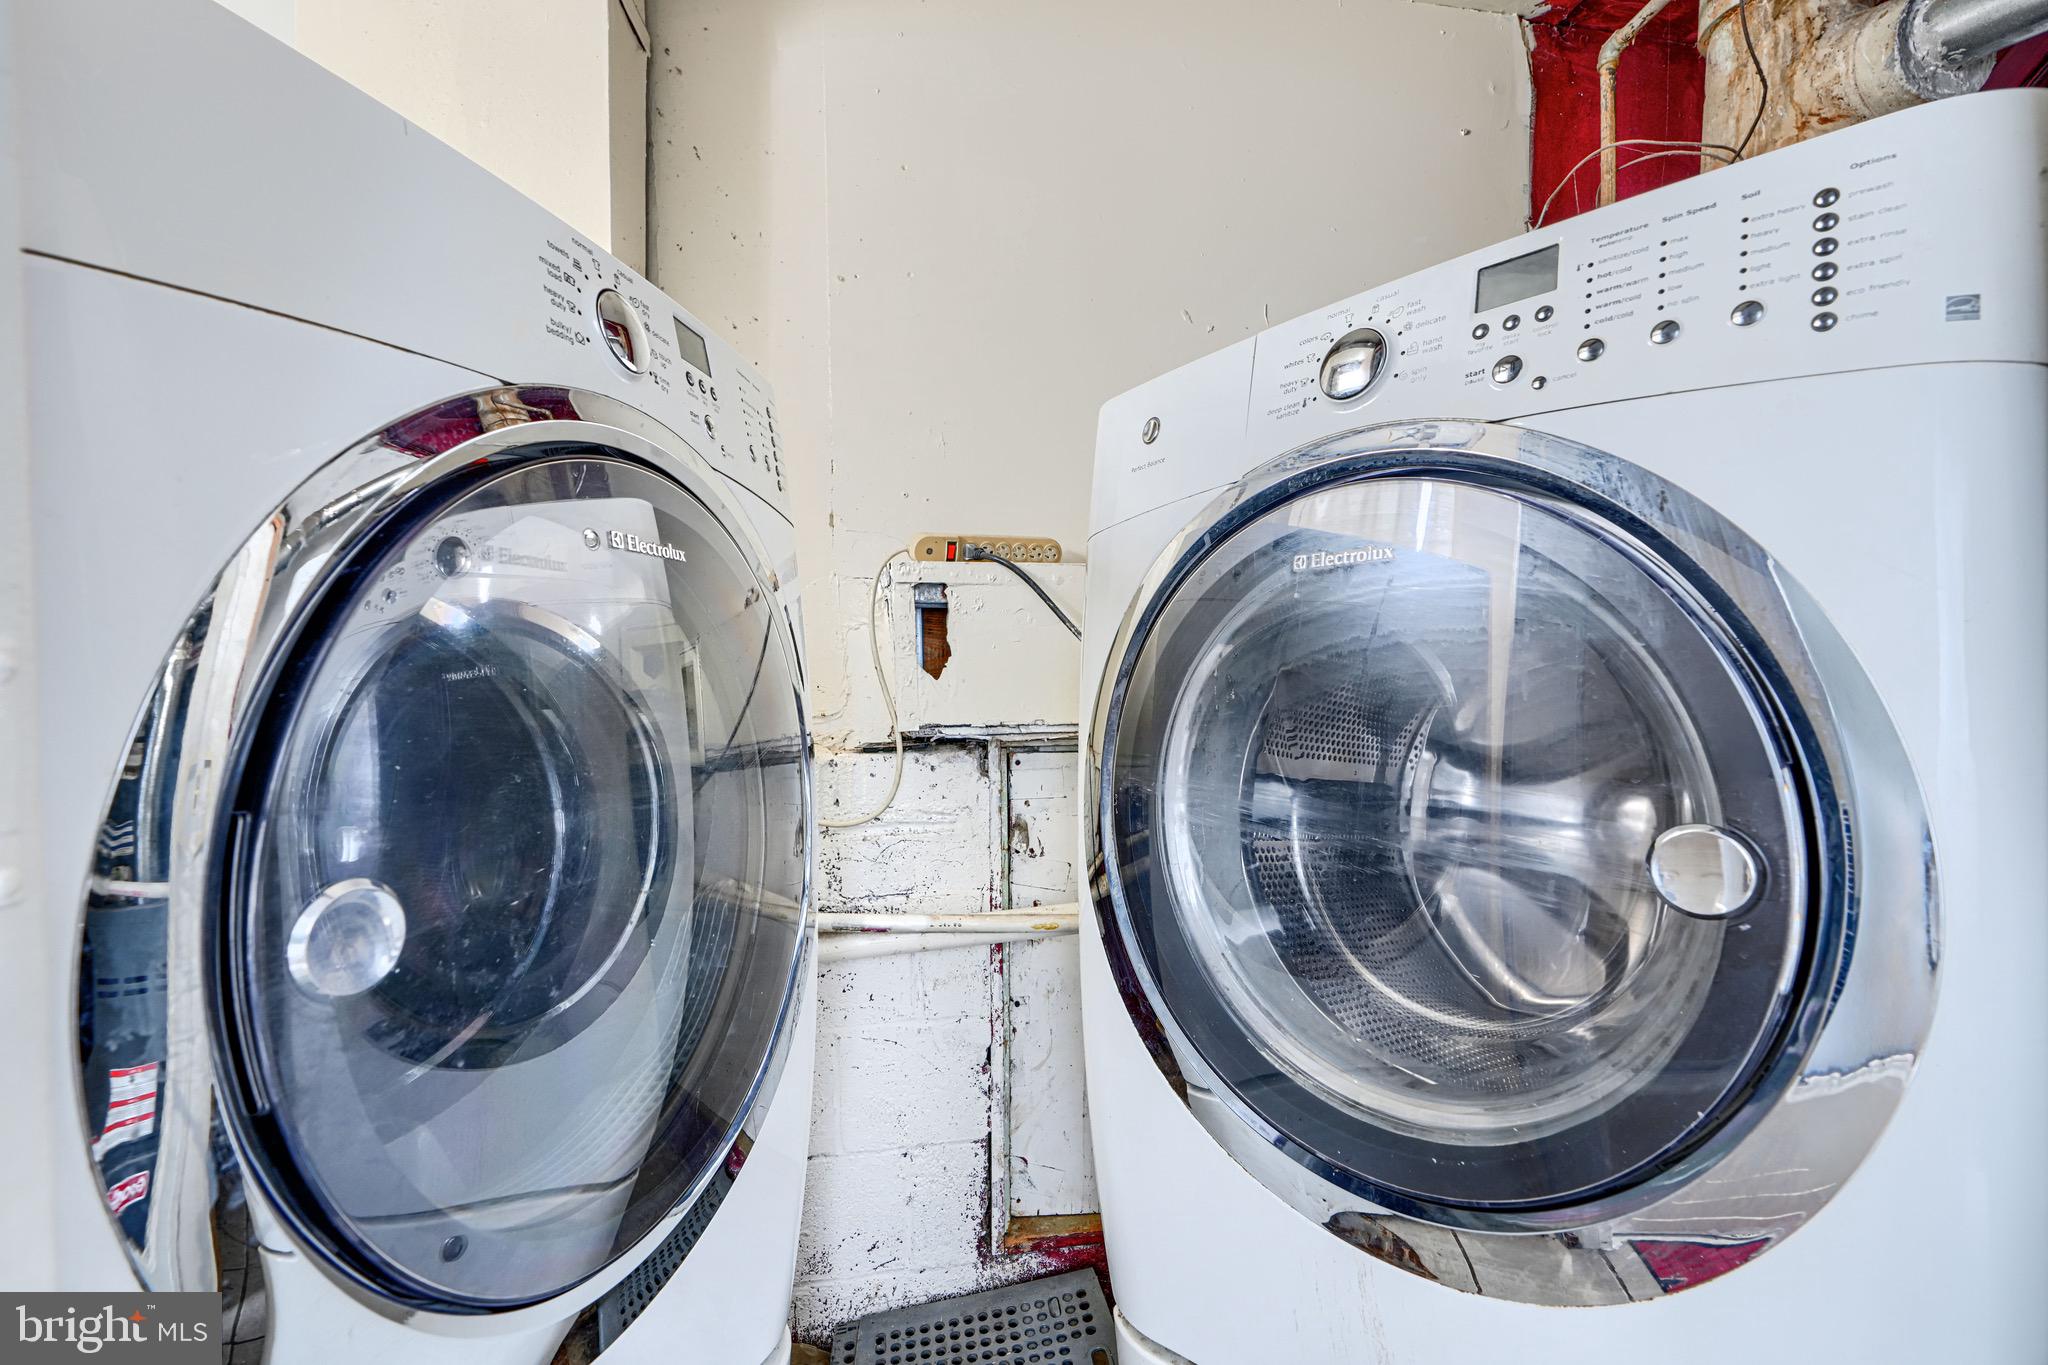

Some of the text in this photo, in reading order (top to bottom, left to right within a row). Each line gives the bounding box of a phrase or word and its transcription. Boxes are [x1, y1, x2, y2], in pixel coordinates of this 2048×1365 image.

[1849, 153, 1898, 170] Options
[1741, 189, 1761, 200] Soil
[1848, 181, 1895, 198] prewash
[1661, 202, 1717, 223] Spin Speed
[1877, 203, 1909, 215] clean
[1591, 223, 1649, 243] Temperature
[1670, 235, 1689, 243] max
[1847, 227, 1908, 246] extra rinse
[546, 240, 569, 260] towels
[538, 256, 561, 273] mixed
[1668, 262, 1705, 275] medium
[1846, 260, 1875, 271] extra
[1597, 265, 1633, 280] hot/cold
[1596, 276, 1650, 295] warm/warm
[543, 285, 566, 303] heavy
[1376, 289, 1401, 303] casual
[1595, 293, 1643, 310] warm/cold
[551, 299, 567, 312] duty
[1407, 299, 1422, 309] fast
[1327, 307, 1351, 321] normal
[1594, 310, 1635, 325] cold/cold
[1415, 315, 1447, 330] delicate
[545, 325, 575, 346] bedding
[1299, 335, 1319, 347] colors
[1422, 336, 1443, 347] hand
[1283, 359, 1305, 370] whites
[1464, 368, 1486, 379] start
[1280, 379, 1299, 389] heavy
[1283, 386, 1298, 396] duty
[627, 533, 688, 563] Electrolux
[1311, 545, 1394, 567] Electrolux
